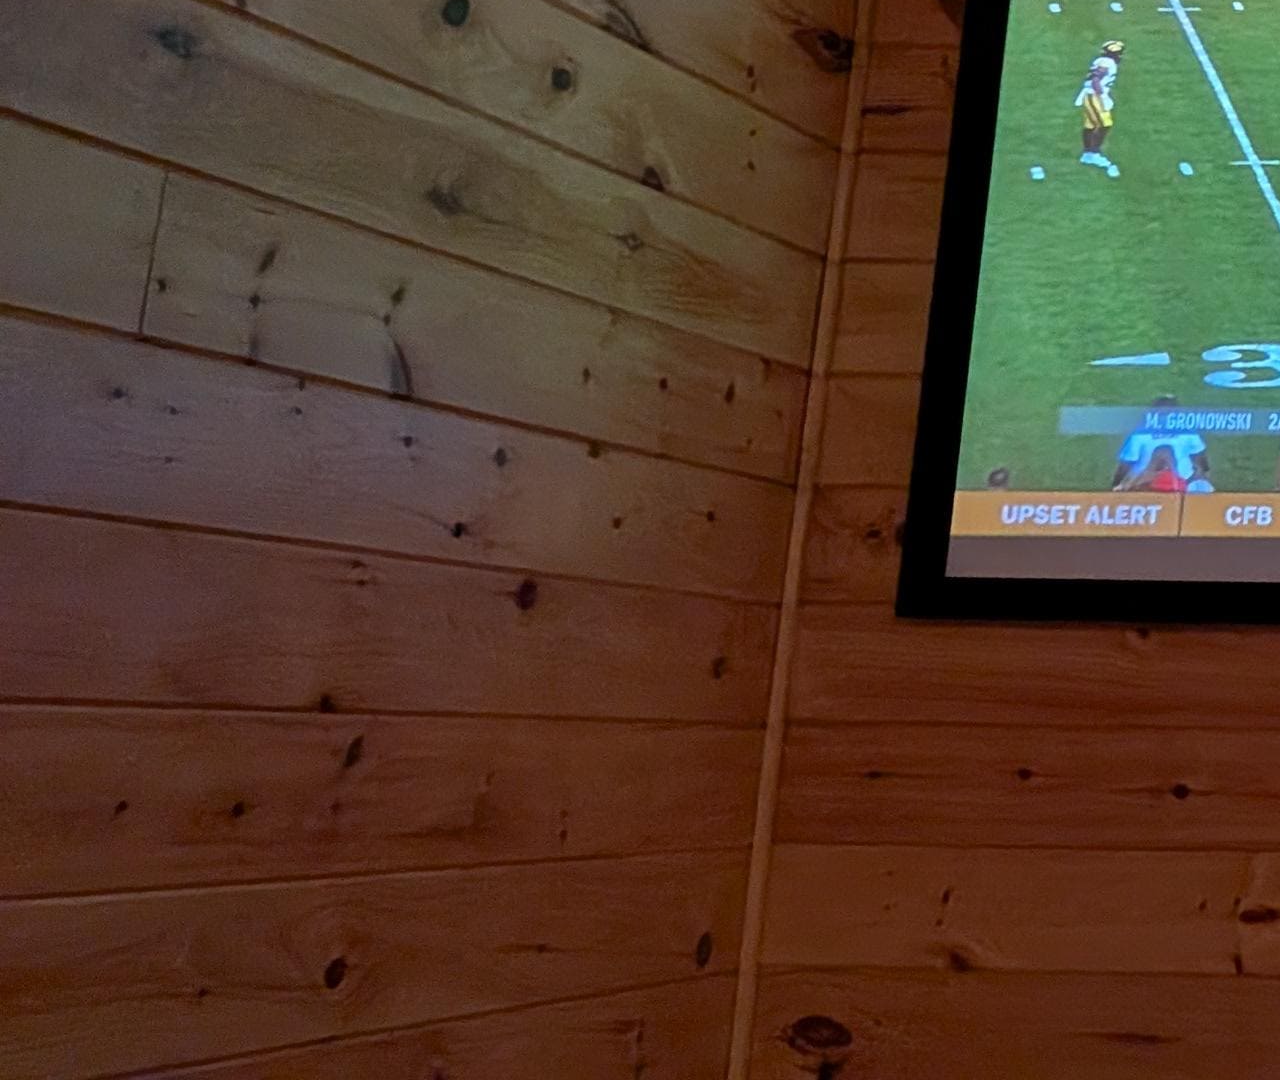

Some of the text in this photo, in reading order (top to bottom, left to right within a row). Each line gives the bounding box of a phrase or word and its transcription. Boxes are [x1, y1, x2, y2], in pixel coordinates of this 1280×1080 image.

[1145, 412, 1162, 431] M.
[1167, 412, 1252, 431] GRONOWSKI
[1001, 504, 1162, 526] UPSET ALERT
[1225, 506, 1273, 526] CFB
